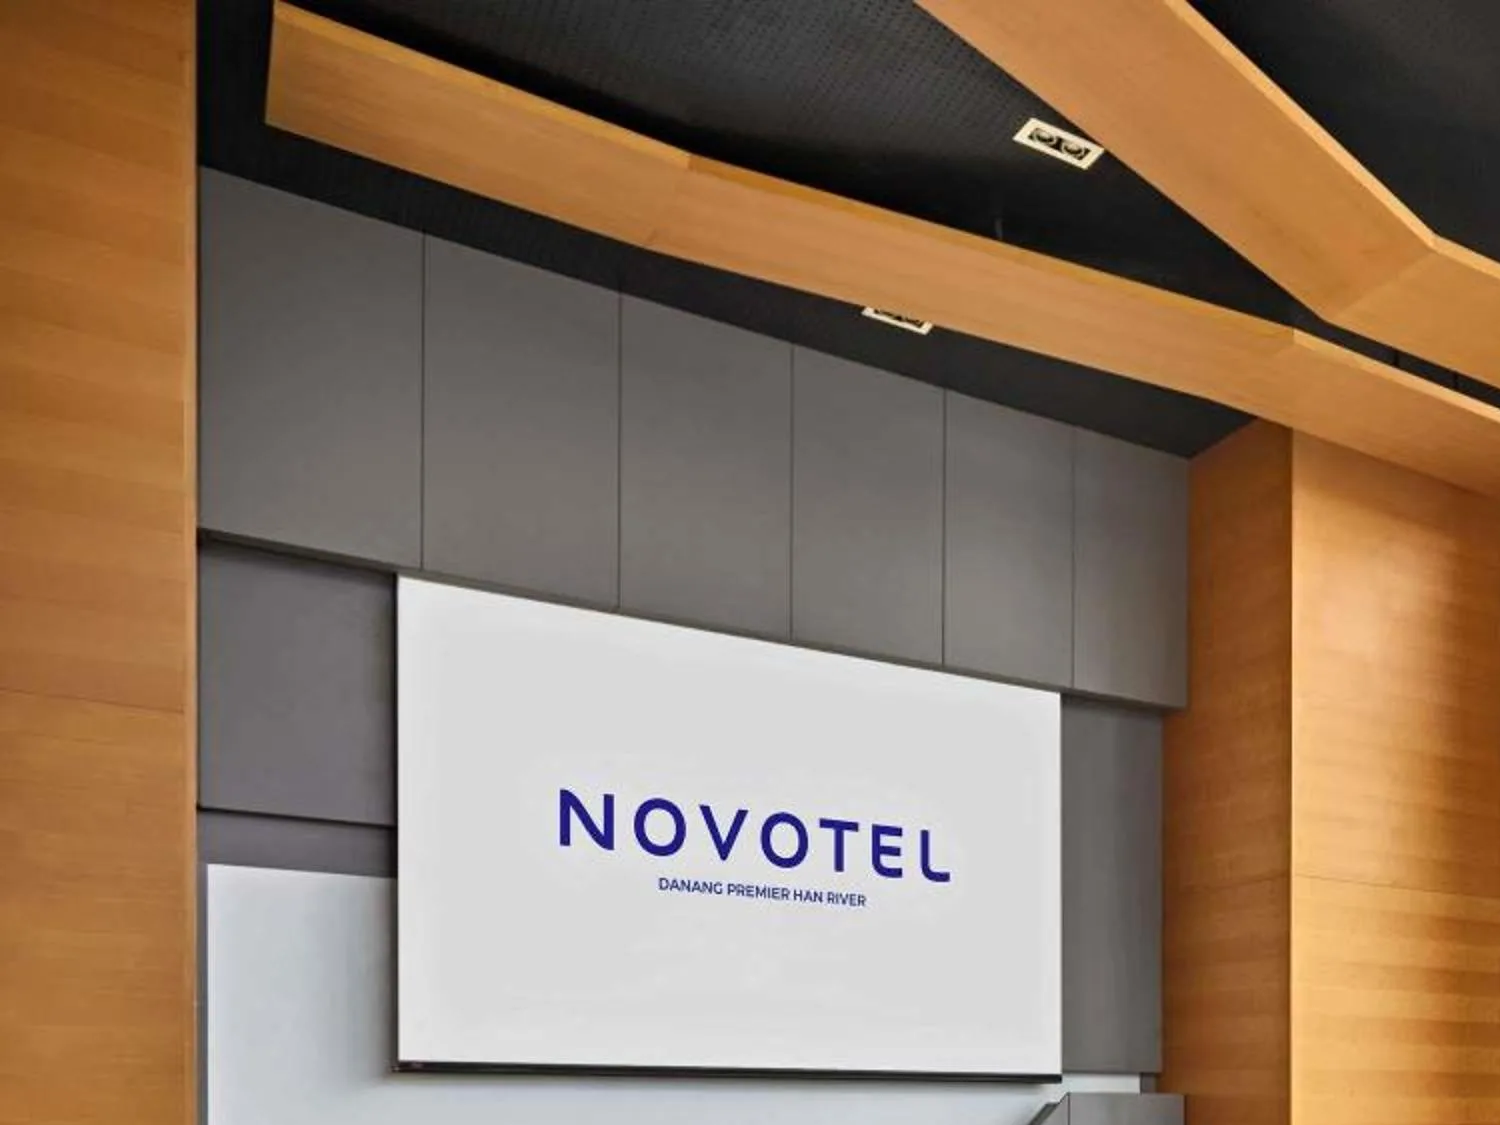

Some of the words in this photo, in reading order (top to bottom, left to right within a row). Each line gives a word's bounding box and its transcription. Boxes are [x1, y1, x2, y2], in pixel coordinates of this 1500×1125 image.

[559, 788, 951, 883] NOVOTEL
[658, 877, 723, 895] DANANG
[727, 883, 791, 901] PREMIER
[793, 889, 823, 903] HAN
[827, 891, 867, 907] RIVER
